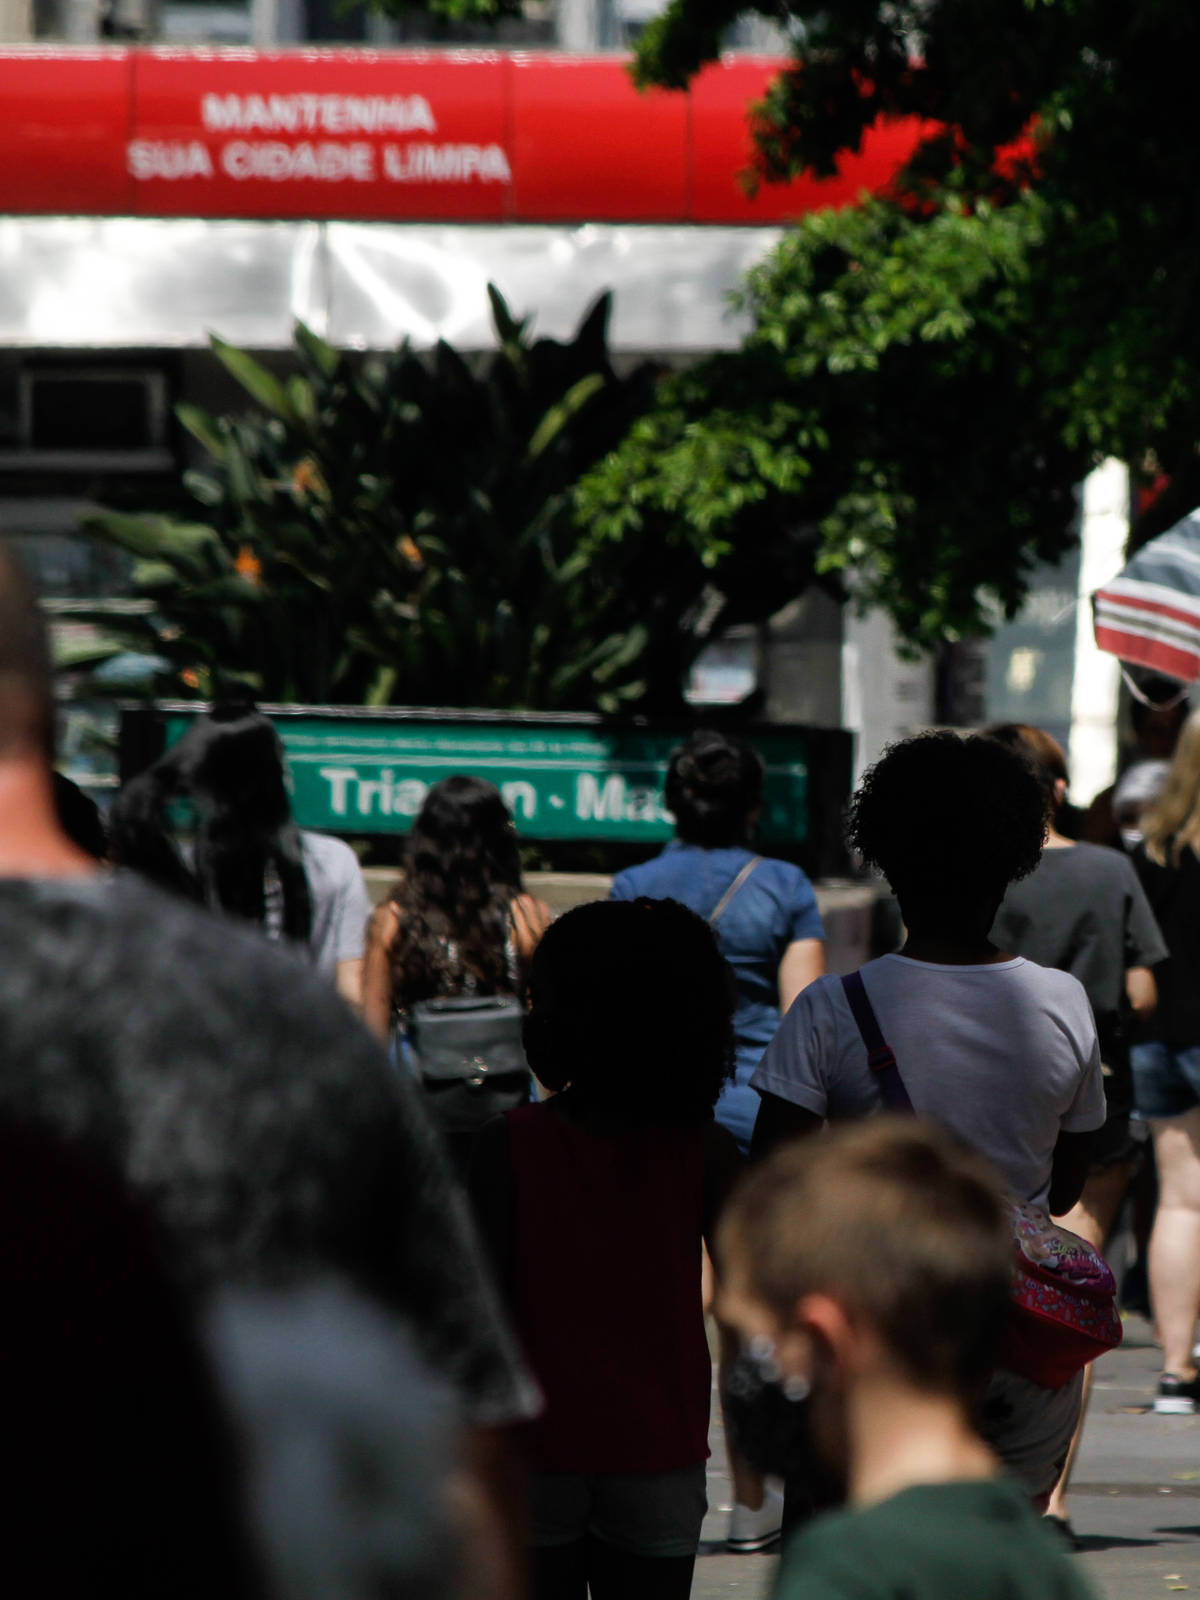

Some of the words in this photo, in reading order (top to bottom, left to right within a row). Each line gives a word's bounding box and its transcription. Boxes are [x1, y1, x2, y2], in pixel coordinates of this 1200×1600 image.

[203, 93, 437, 132] MANTENHA
[126, 140, 213, 181] SUA
[221, 140, 376, 181] CIDADE
[383, 142, 513, 183] LIMPA
[319, 765, 538, 819] Trian
